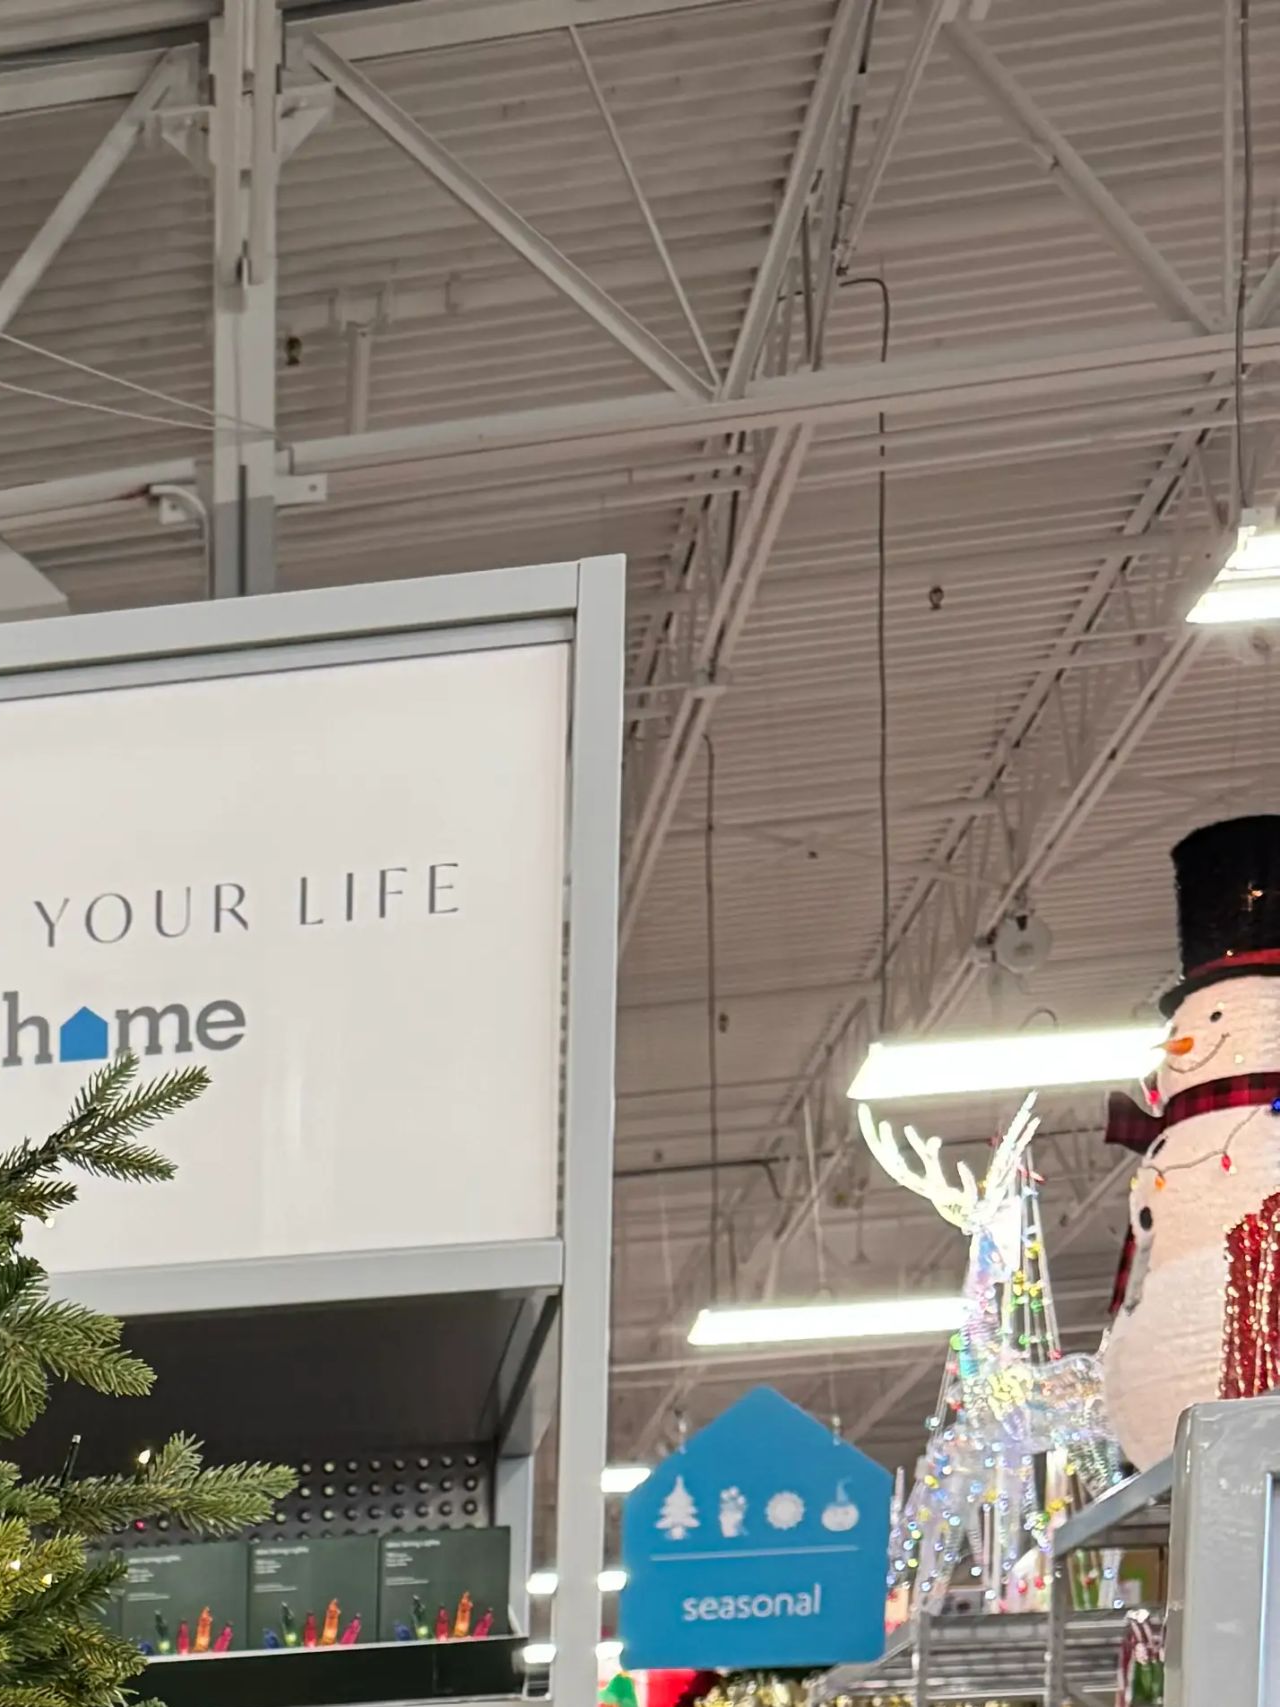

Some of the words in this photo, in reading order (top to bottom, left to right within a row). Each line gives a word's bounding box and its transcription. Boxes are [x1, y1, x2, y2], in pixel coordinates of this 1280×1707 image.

[35, 882, 251, 949] YOUR
[298, 863, 462, 928] LIFE
[682, 1582, 822, 1622] seasonal
